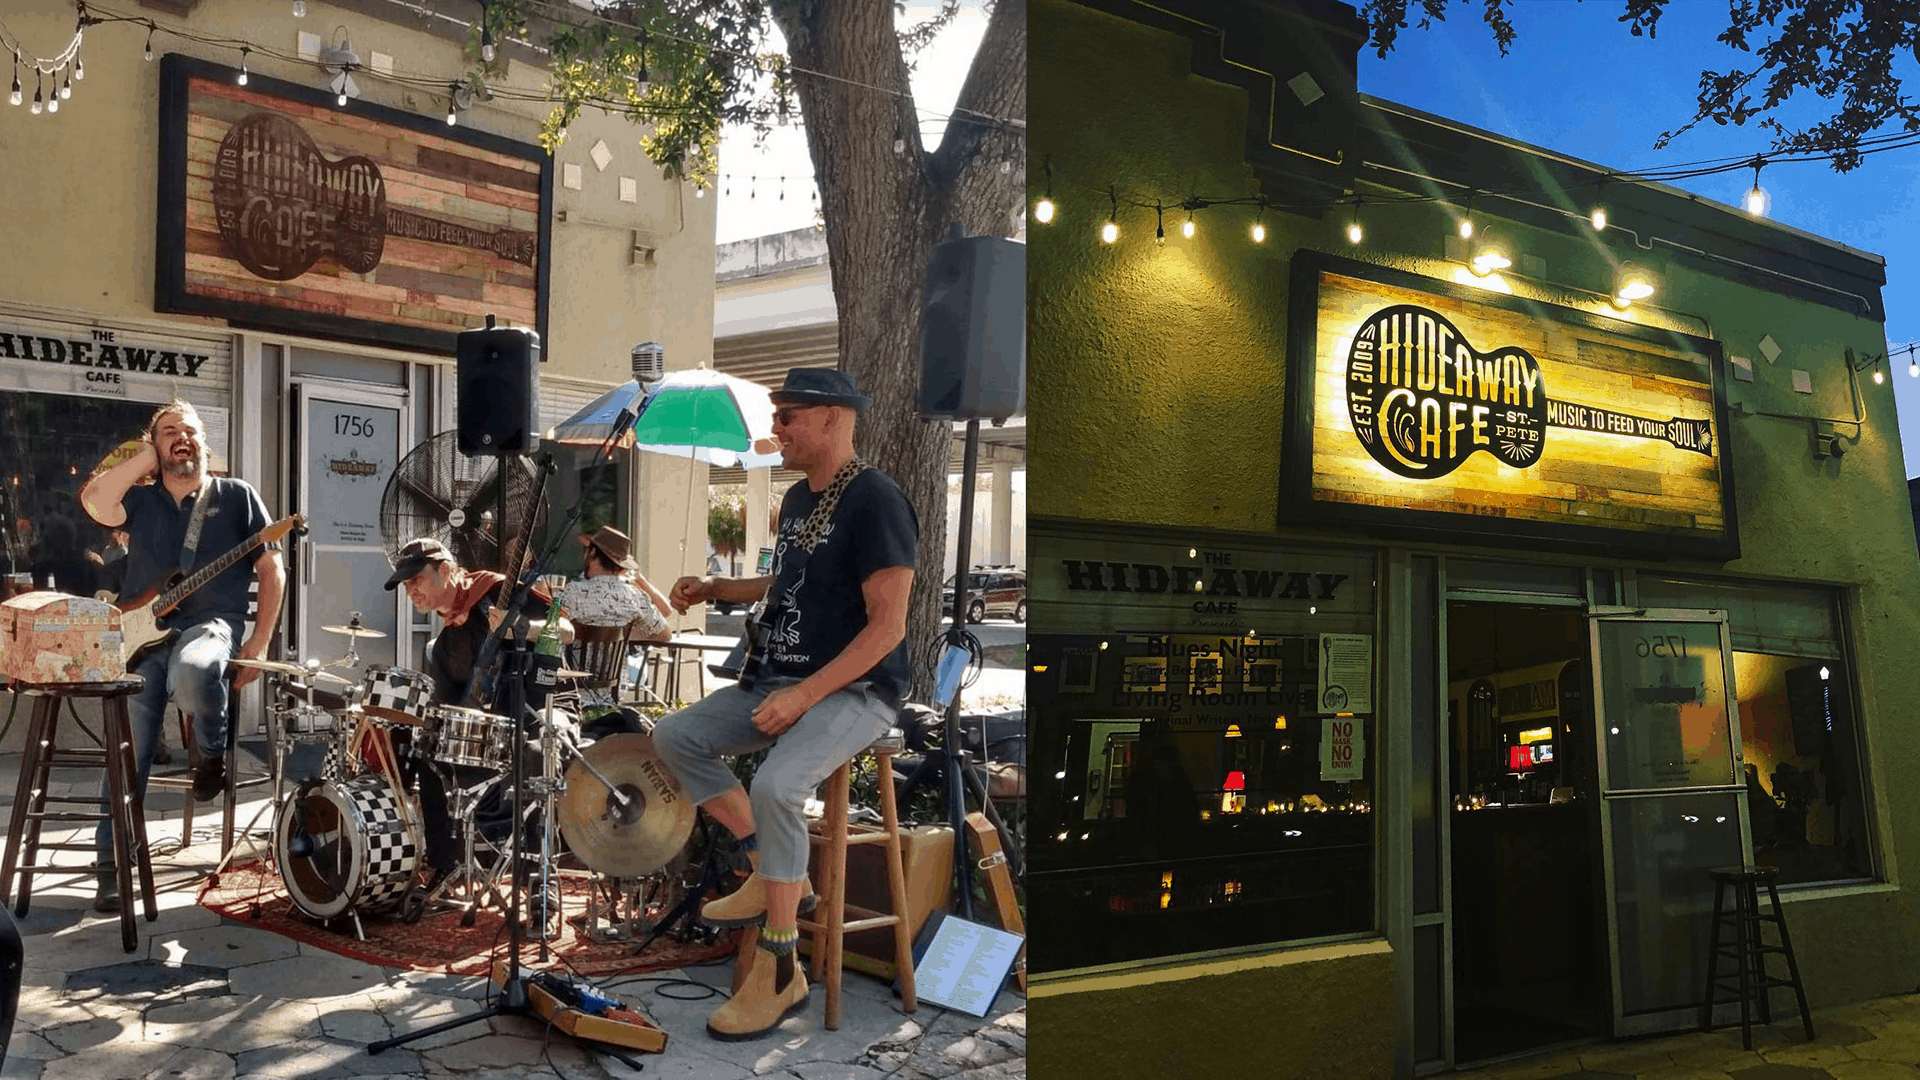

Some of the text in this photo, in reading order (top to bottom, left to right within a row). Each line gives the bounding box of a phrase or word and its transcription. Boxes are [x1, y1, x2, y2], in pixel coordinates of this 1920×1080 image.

[386, 212, 519, 259] MUSIC TO FEED YOUR SOUL
[91, 330, 115, 342] THE
[1378, 313, 1538, 408] HIDEAWAY
[86, 371, 121, 384] CAFE
[1351, 340, 1374, 426] EST. 2009
[334, 414, 374, 438] 1756
[1377, 388, 1490, 469] CAFE
[1496, 425, 1539, 442] PETE
[1547, 400, 1697, 448] MUSIC TO FEED YOUR SOUL
[1203, 553, 1231, 565] THE
[1062, 560, 1348, 600] HIDEAWAY
[1193, 601, 1237, 614] CAFE
[1148, 637, 1281, 663] Blues Night
[1112, 686, 1183, 712] Living
[1191, 686, 1258, 706] Room
[1266, 687, 1307, 706] Live
[1332, 722, 1353, 738] NO
[1332, 745, 1352, 761] NO
[641, 760, 676, 803] SABIAN
